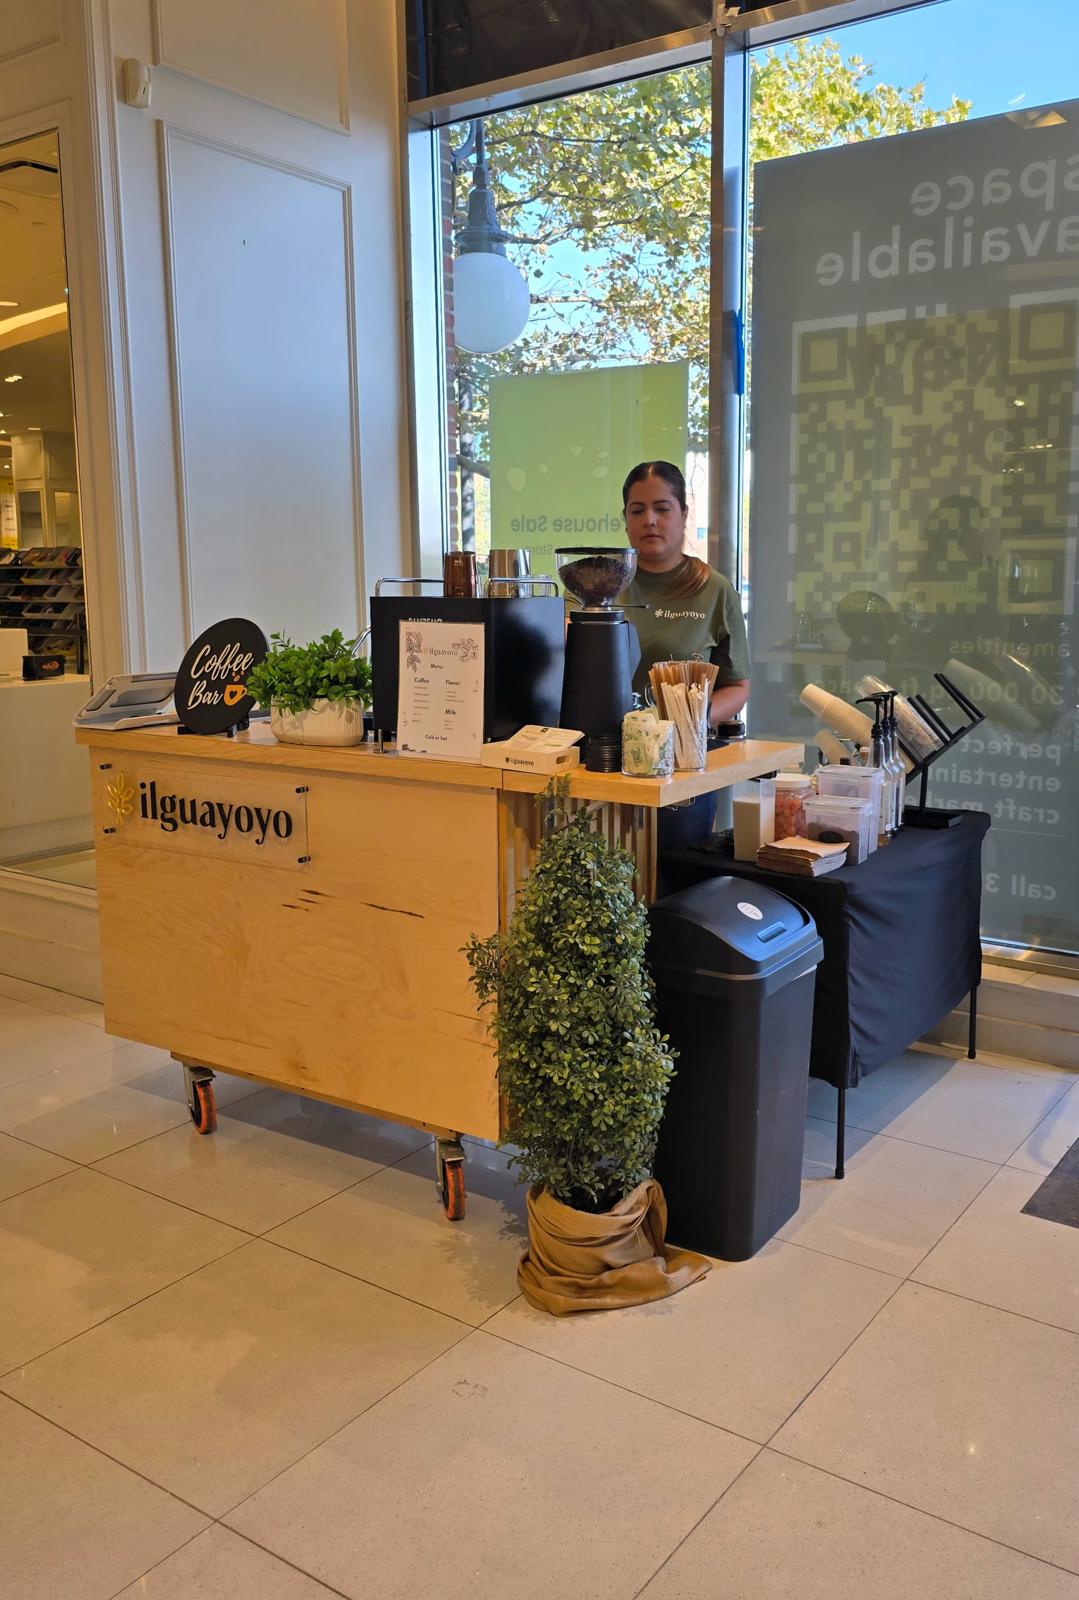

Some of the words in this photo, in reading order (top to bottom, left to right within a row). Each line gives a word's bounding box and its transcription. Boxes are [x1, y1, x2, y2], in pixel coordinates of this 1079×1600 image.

[663, 609, 706, 620] ilguayoyo
[191, 642, 254, 680] Coffee
[187, 680, 224, 710] Bar
[139, 780, 293, 845] ilguayoyo
